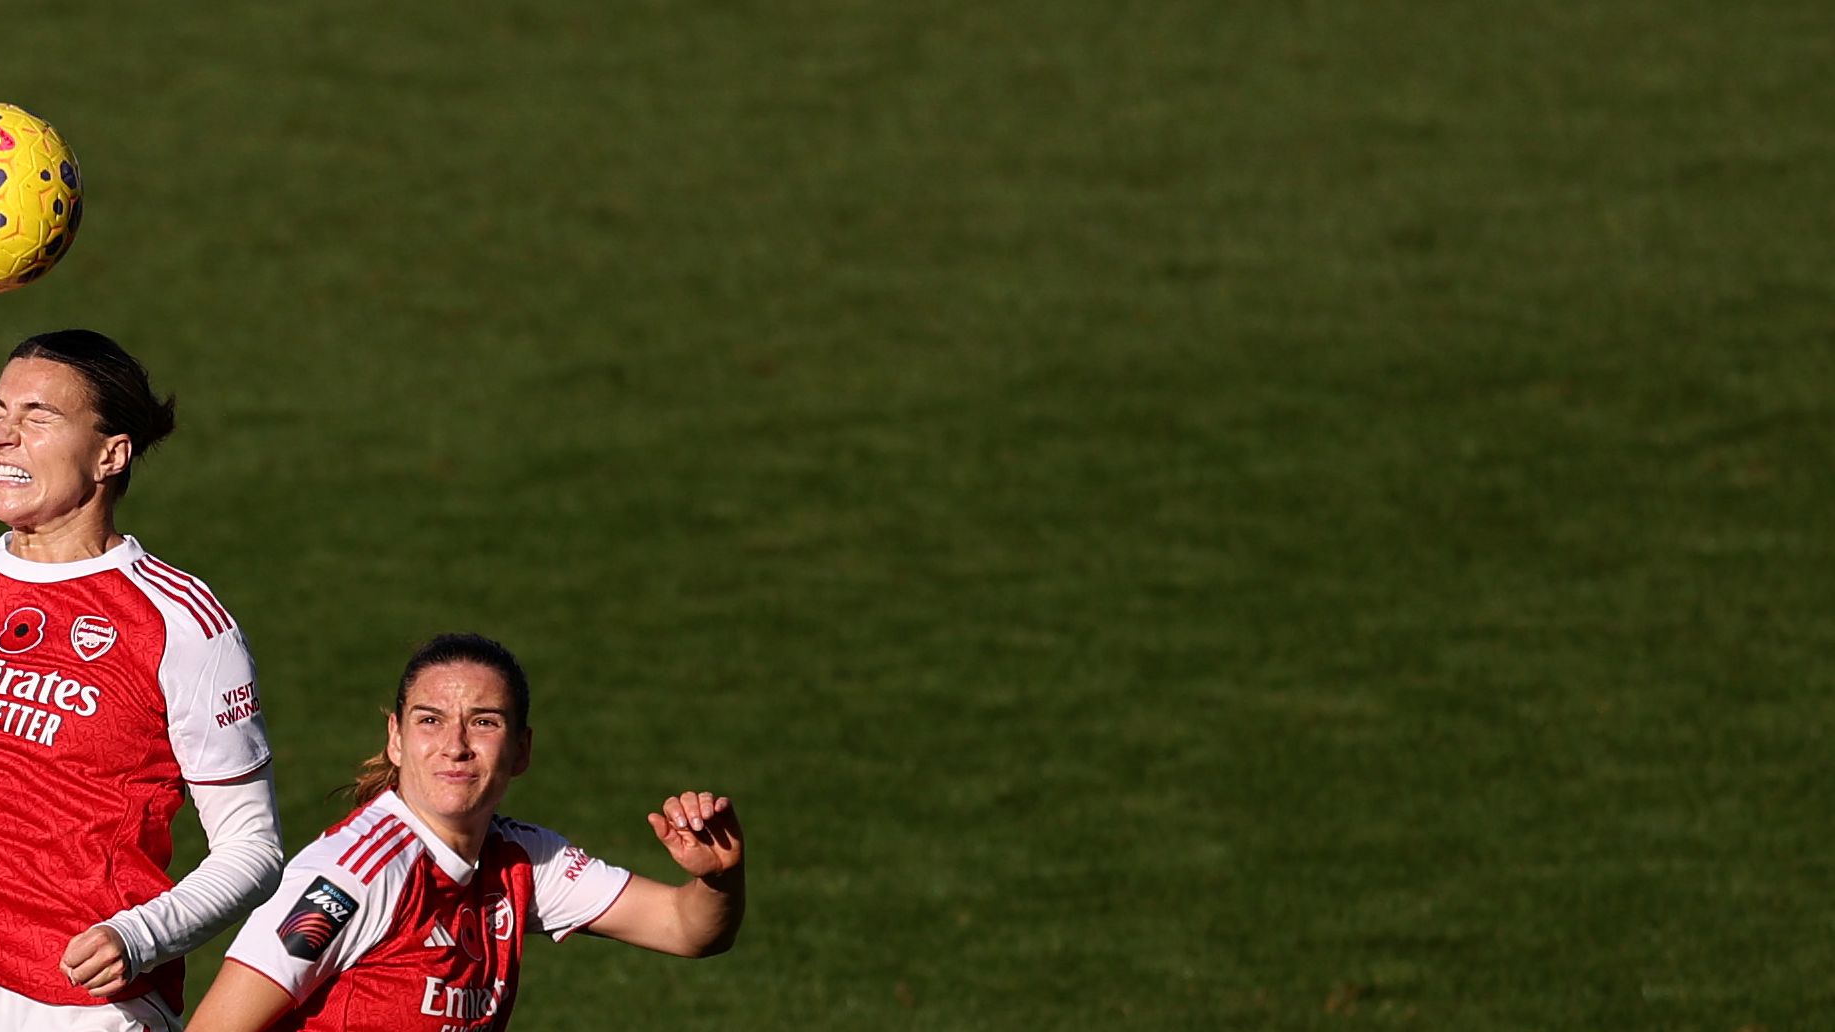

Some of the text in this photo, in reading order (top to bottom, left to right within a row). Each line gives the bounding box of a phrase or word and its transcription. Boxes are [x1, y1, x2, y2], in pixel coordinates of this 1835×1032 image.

[222, 681, 254, 706] VISIT
[215, 697, 260, 728] RWAND
[305, 889, 349, 923] WSL
